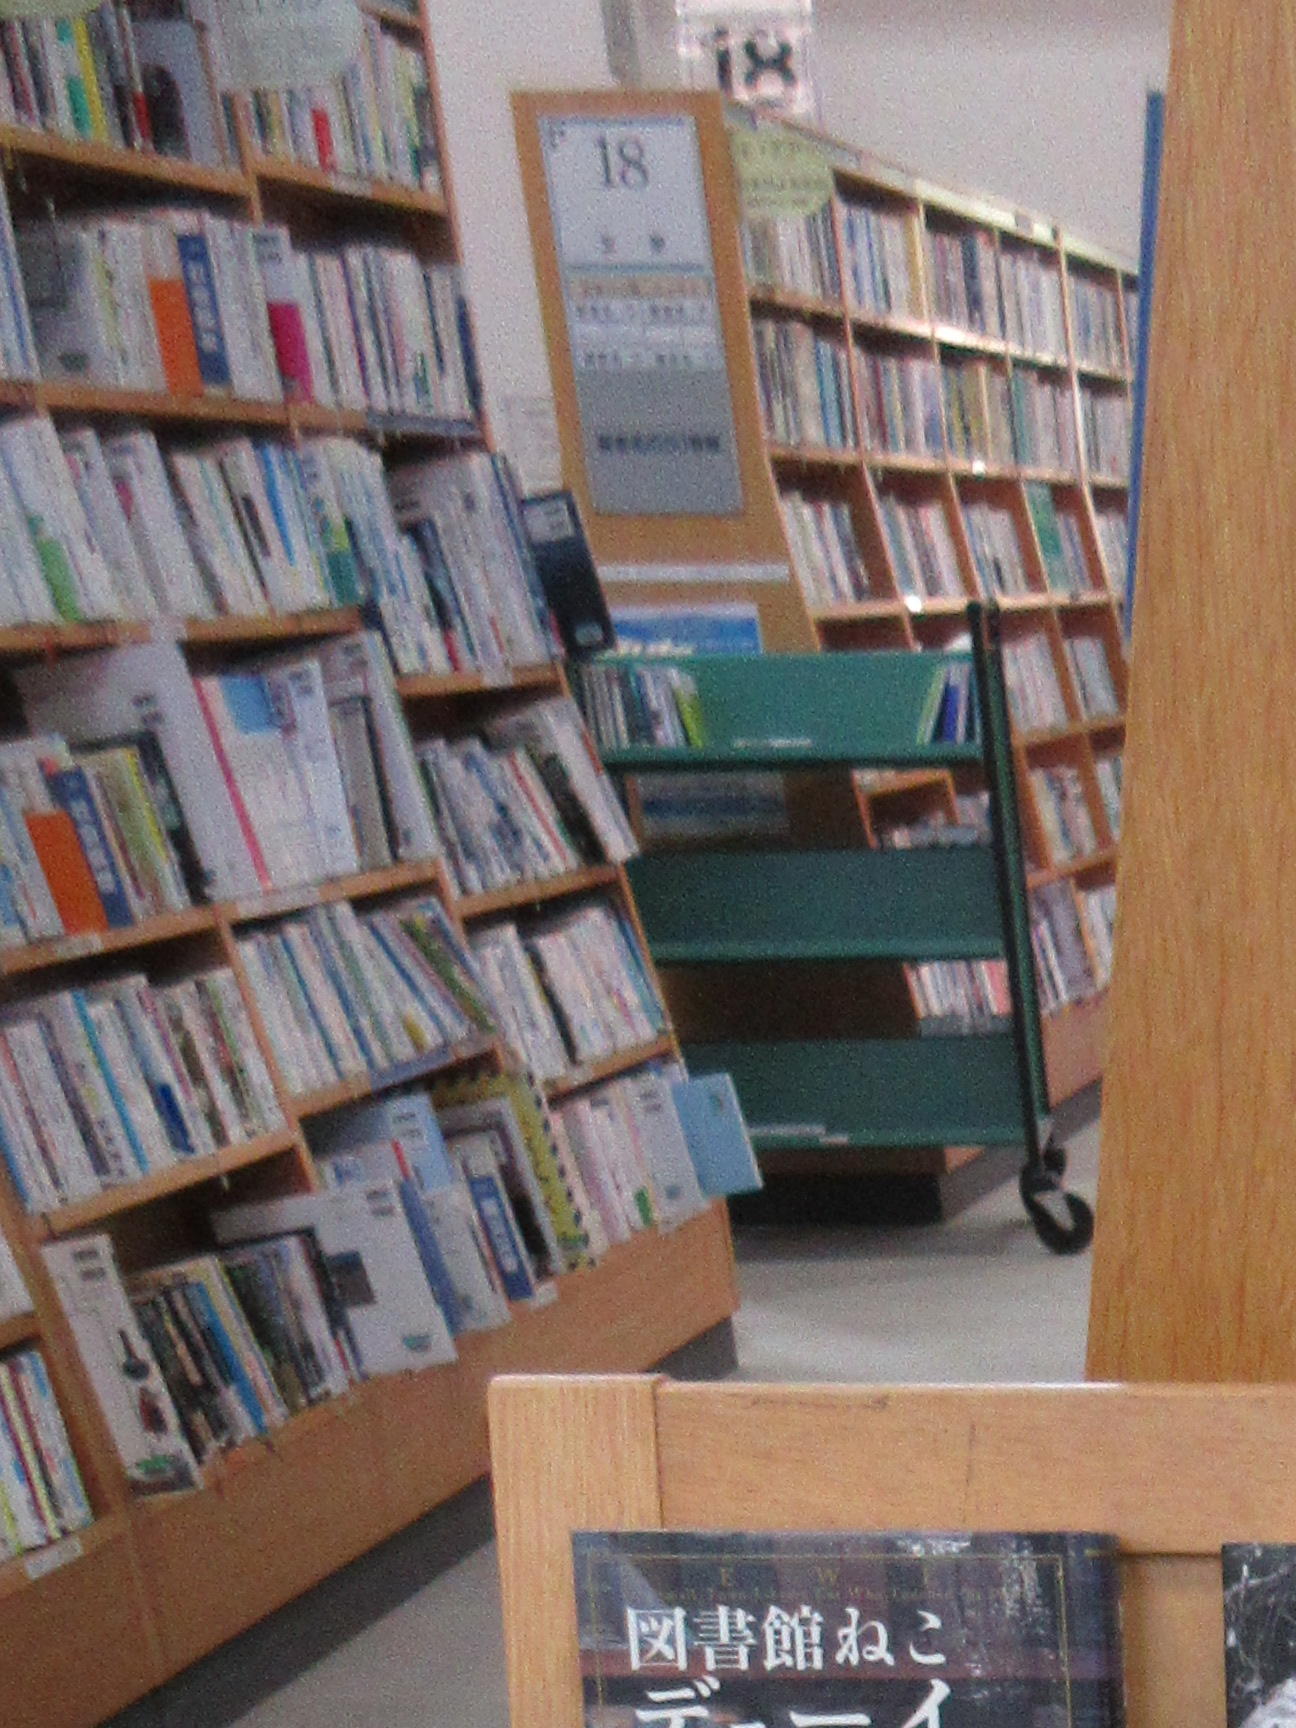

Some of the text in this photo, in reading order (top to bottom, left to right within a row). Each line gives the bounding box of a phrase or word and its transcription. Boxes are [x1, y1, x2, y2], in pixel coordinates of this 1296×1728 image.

[597, 136, 650, 190] 18
[625, 1606, 948, 1672] 図書館ねこ
